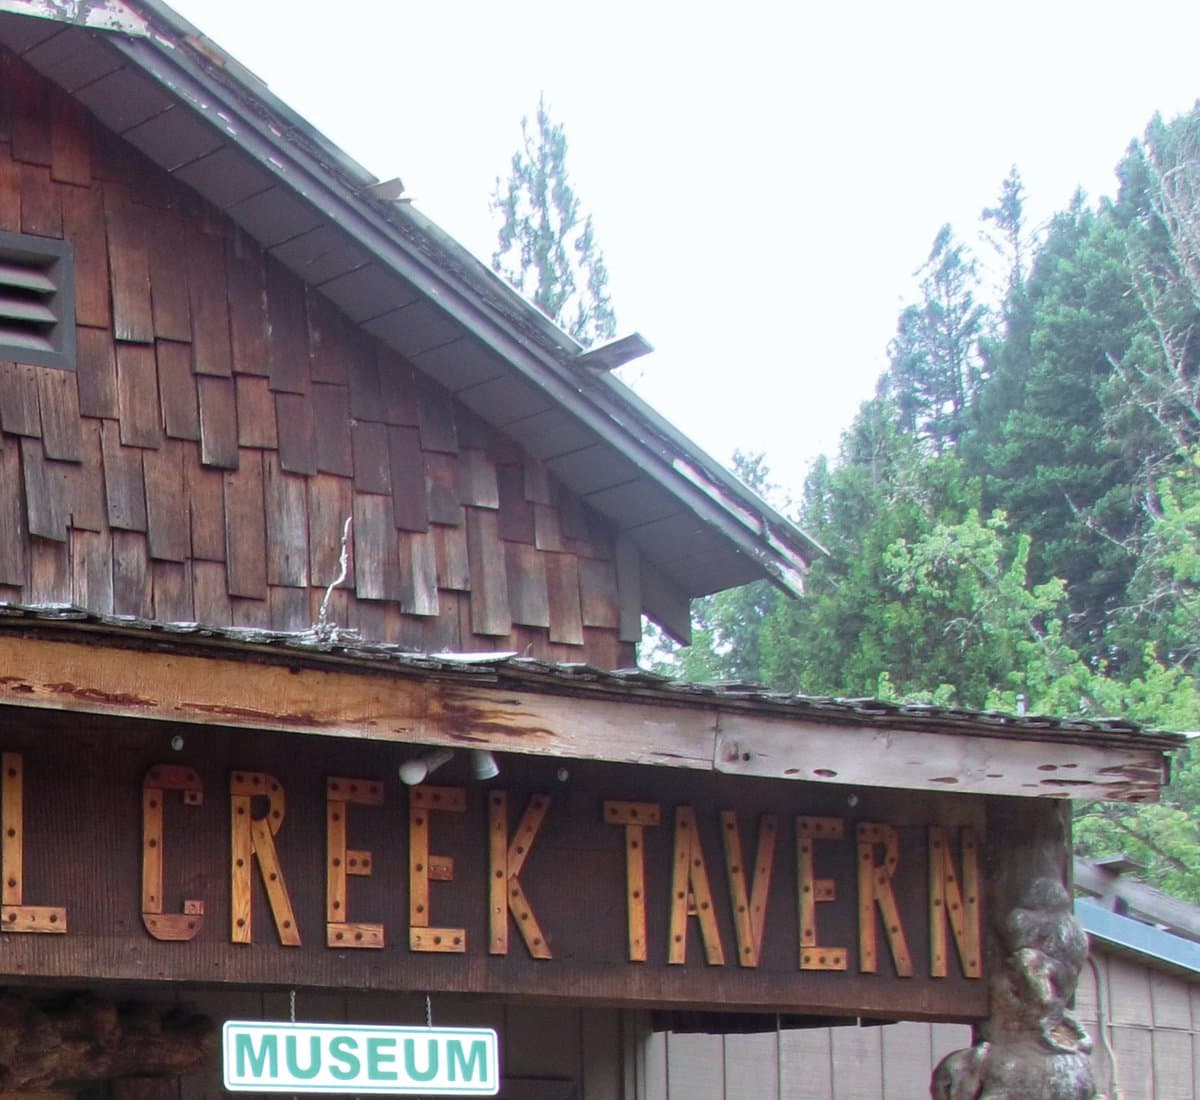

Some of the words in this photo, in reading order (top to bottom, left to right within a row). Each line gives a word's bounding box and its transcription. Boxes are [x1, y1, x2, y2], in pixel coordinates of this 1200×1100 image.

[141, 762, 553, 961] CREEK
[603, 801, 984, 980] TAVERN
[234, 1033, 488, 1083] MUSEUM
